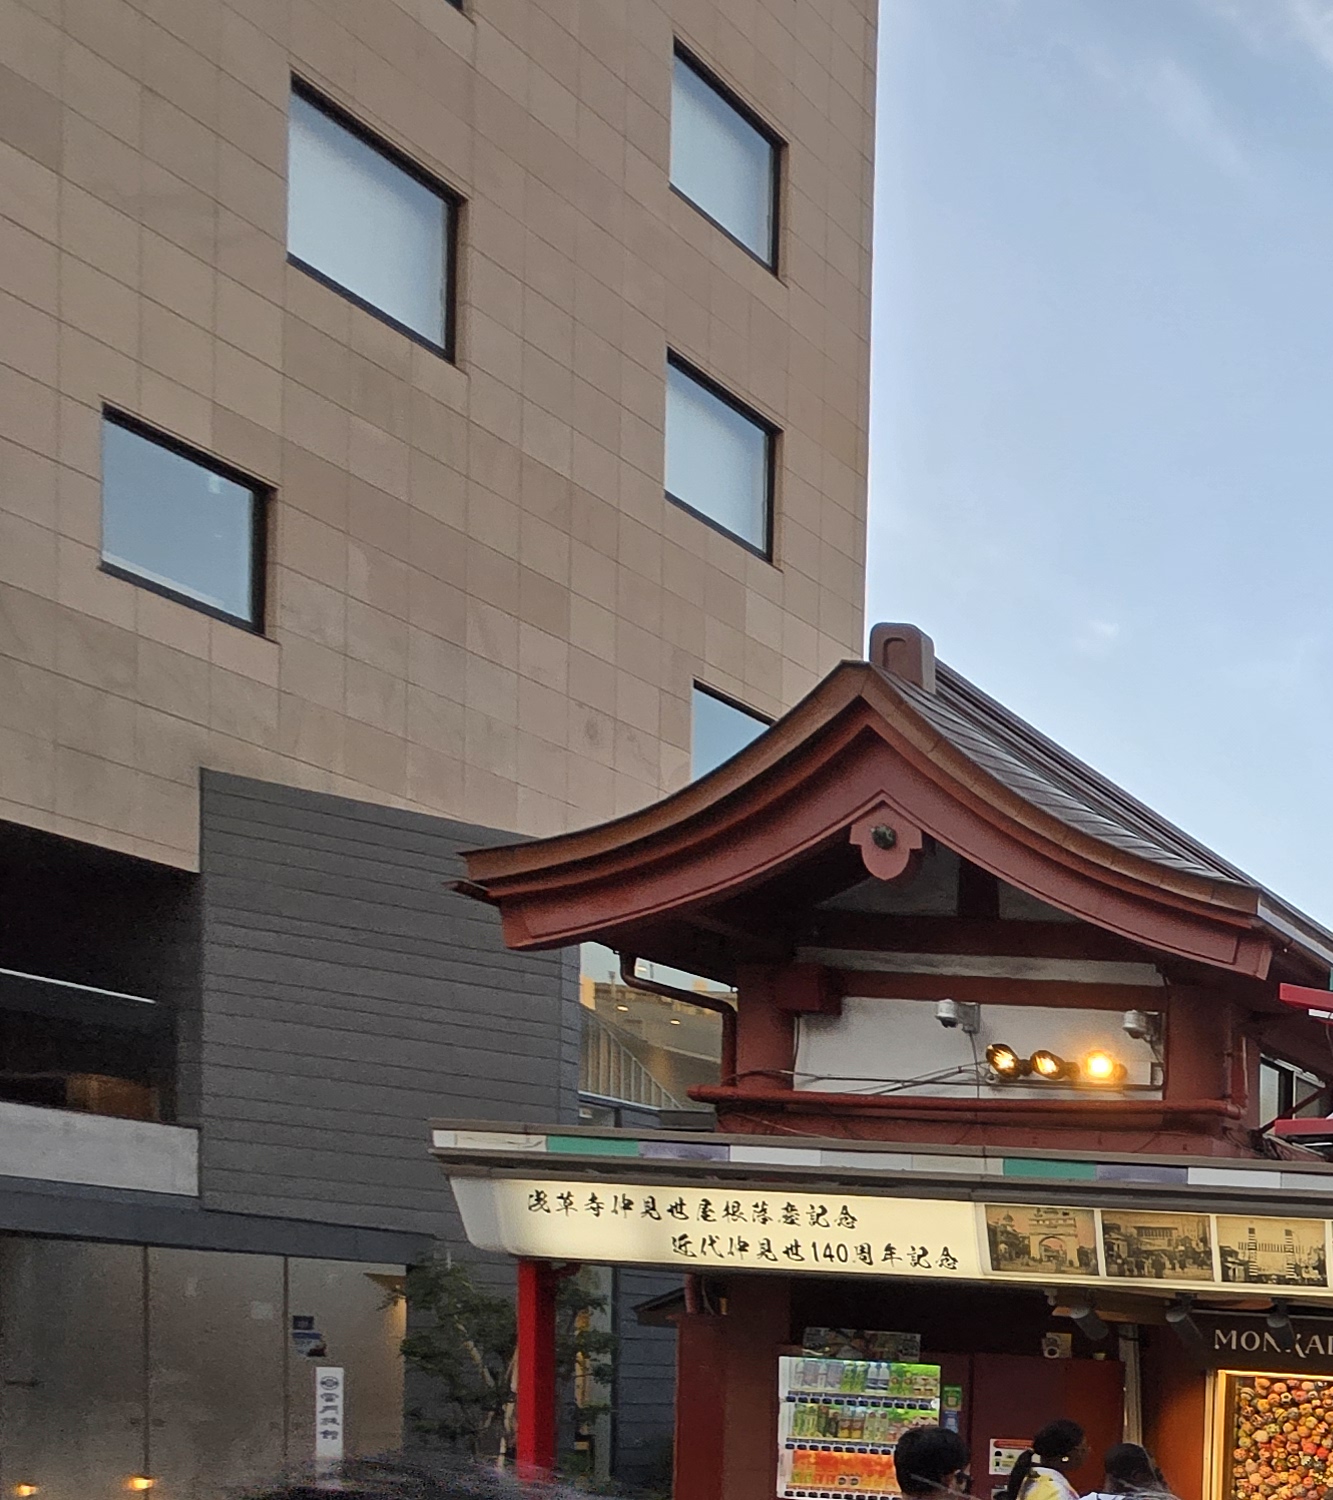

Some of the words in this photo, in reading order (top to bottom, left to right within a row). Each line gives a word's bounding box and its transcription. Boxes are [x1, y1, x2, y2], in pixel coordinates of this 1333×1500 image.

[671, 1234, 958, 1270] 近代仲見世140周年記念
